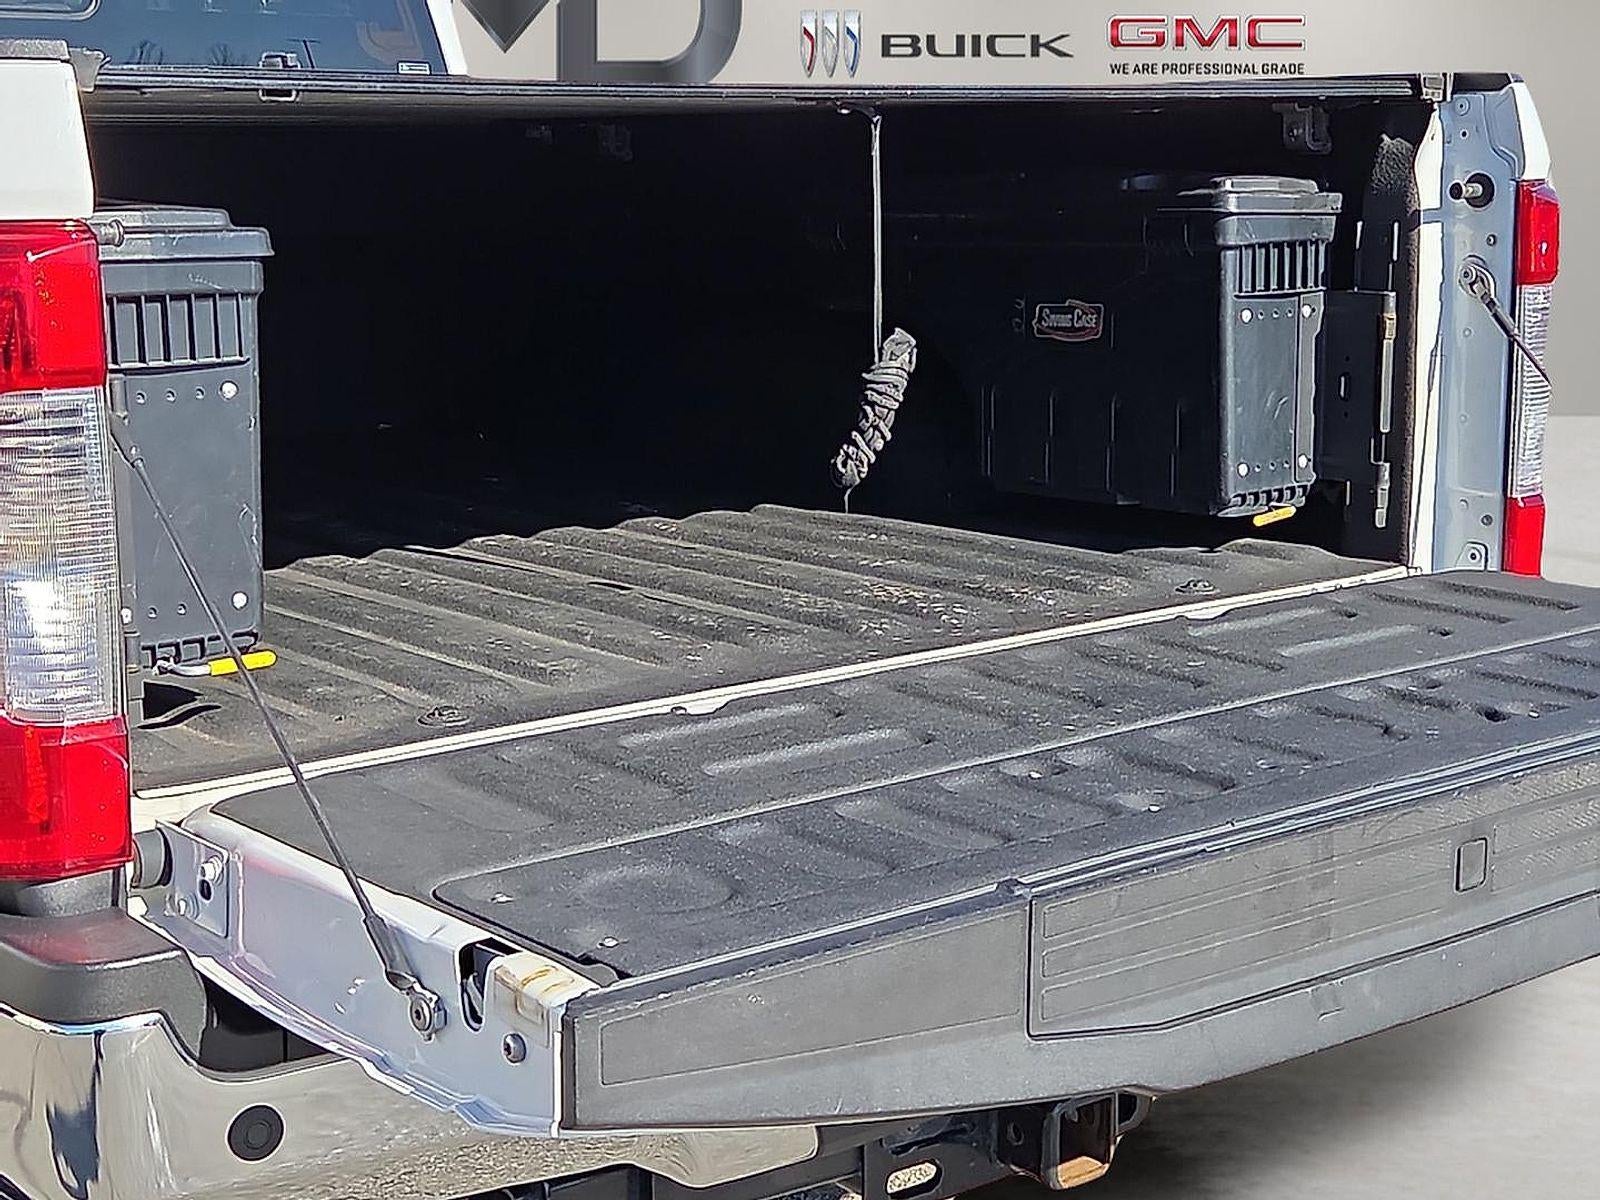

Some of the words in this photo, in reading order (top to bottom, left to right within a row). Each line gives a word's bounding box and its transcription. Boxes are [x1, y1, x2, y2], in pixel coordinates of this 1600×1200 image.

[1108, 15, 1306, 50] GMC
[881, 34, 1074, 57] BUICK
[1109, 62, 1129, 75] WE
[1132, 62, 1158, 75] ARE
[1161, 62, 1258, 75] PROFESSIONAL
[1261, 62, 1305, 75] GRADE
